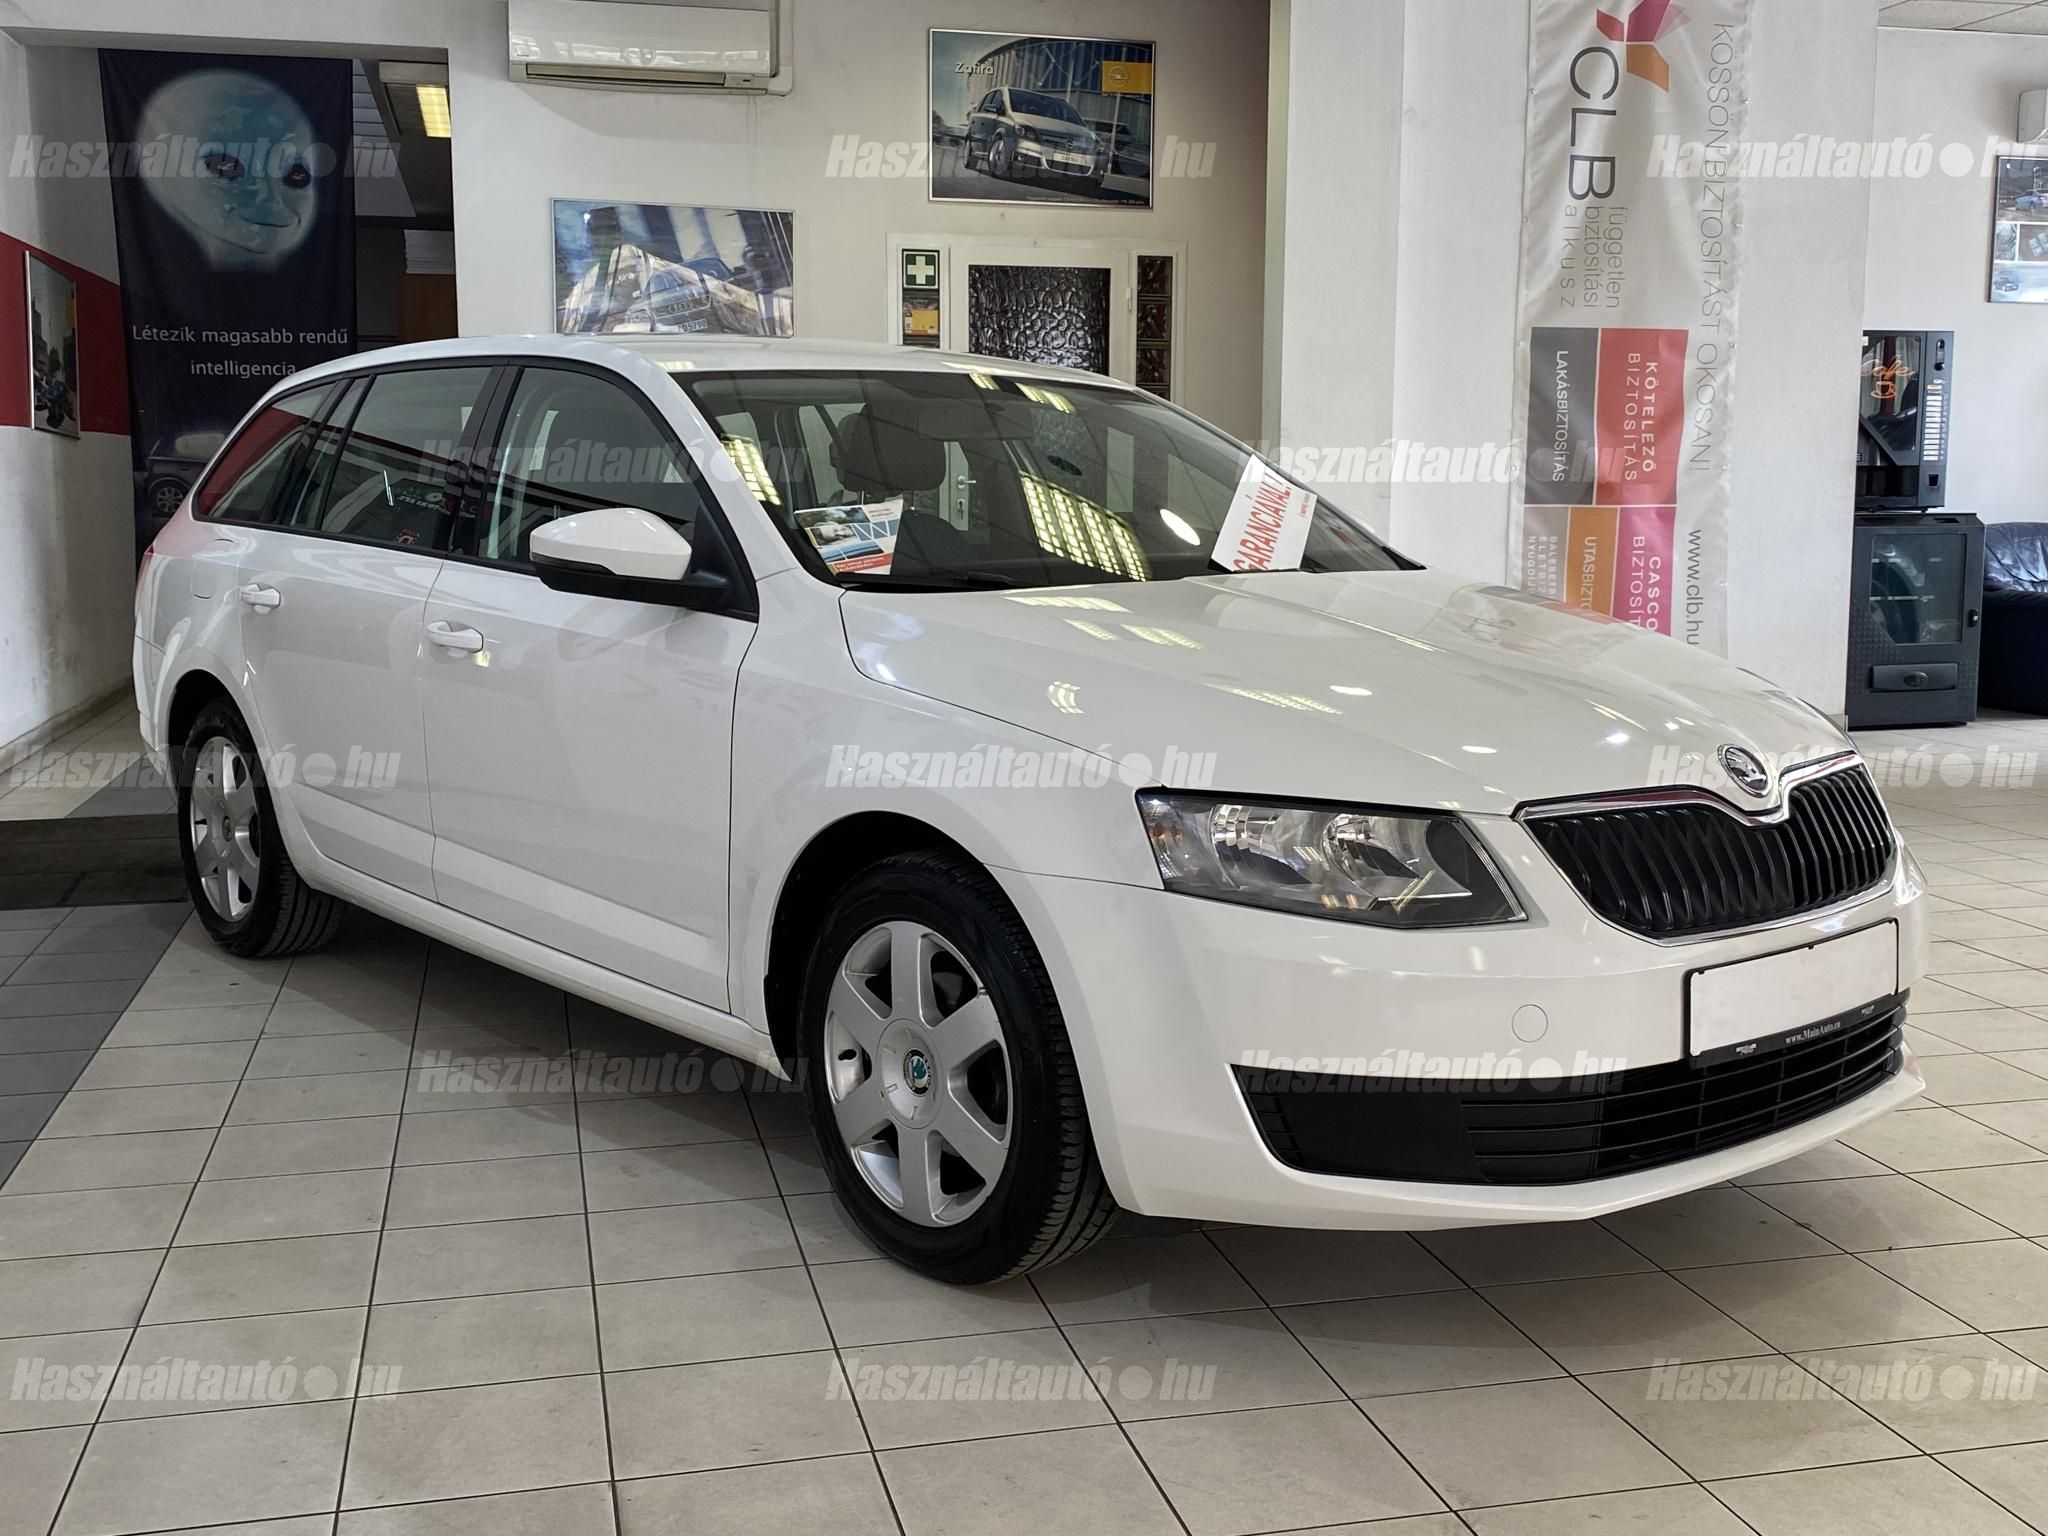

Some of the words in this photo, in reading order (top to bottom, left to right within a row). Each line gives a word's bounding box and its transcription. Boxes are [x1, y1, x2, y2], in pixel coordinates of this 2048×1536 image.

[955, 61, 994, 75] Zafira
[1704, 23, 1739, 148] KÖSSÖN
[1568, 46, 1619, 201] CLB
[1560, 204, 1581, 308] alkusz
[1583, 206, 1604, 308] biztosítási
[1603, 206, 1628, 309] független
[1700, 160, 1728, 334] BIZTOSÍTÁST
[132, 325, 196, 342] Létezik
[202, 328, 293, 347] magasabb
[299, 328, 348, 344] rendű
[189, 360, 297, 379] intelligencia
[1552, 350, 1569, 482] LAKÁSBIZTOSÍTÁS
[1623, 353, 1641, 481] BIZTOSÍTÁS
[1689, 343, 1718, 472] OKOSAN!
[1646, 556, 1662, 630] CASCO
[1686, 529, 1705, 646] www.clb.hu
